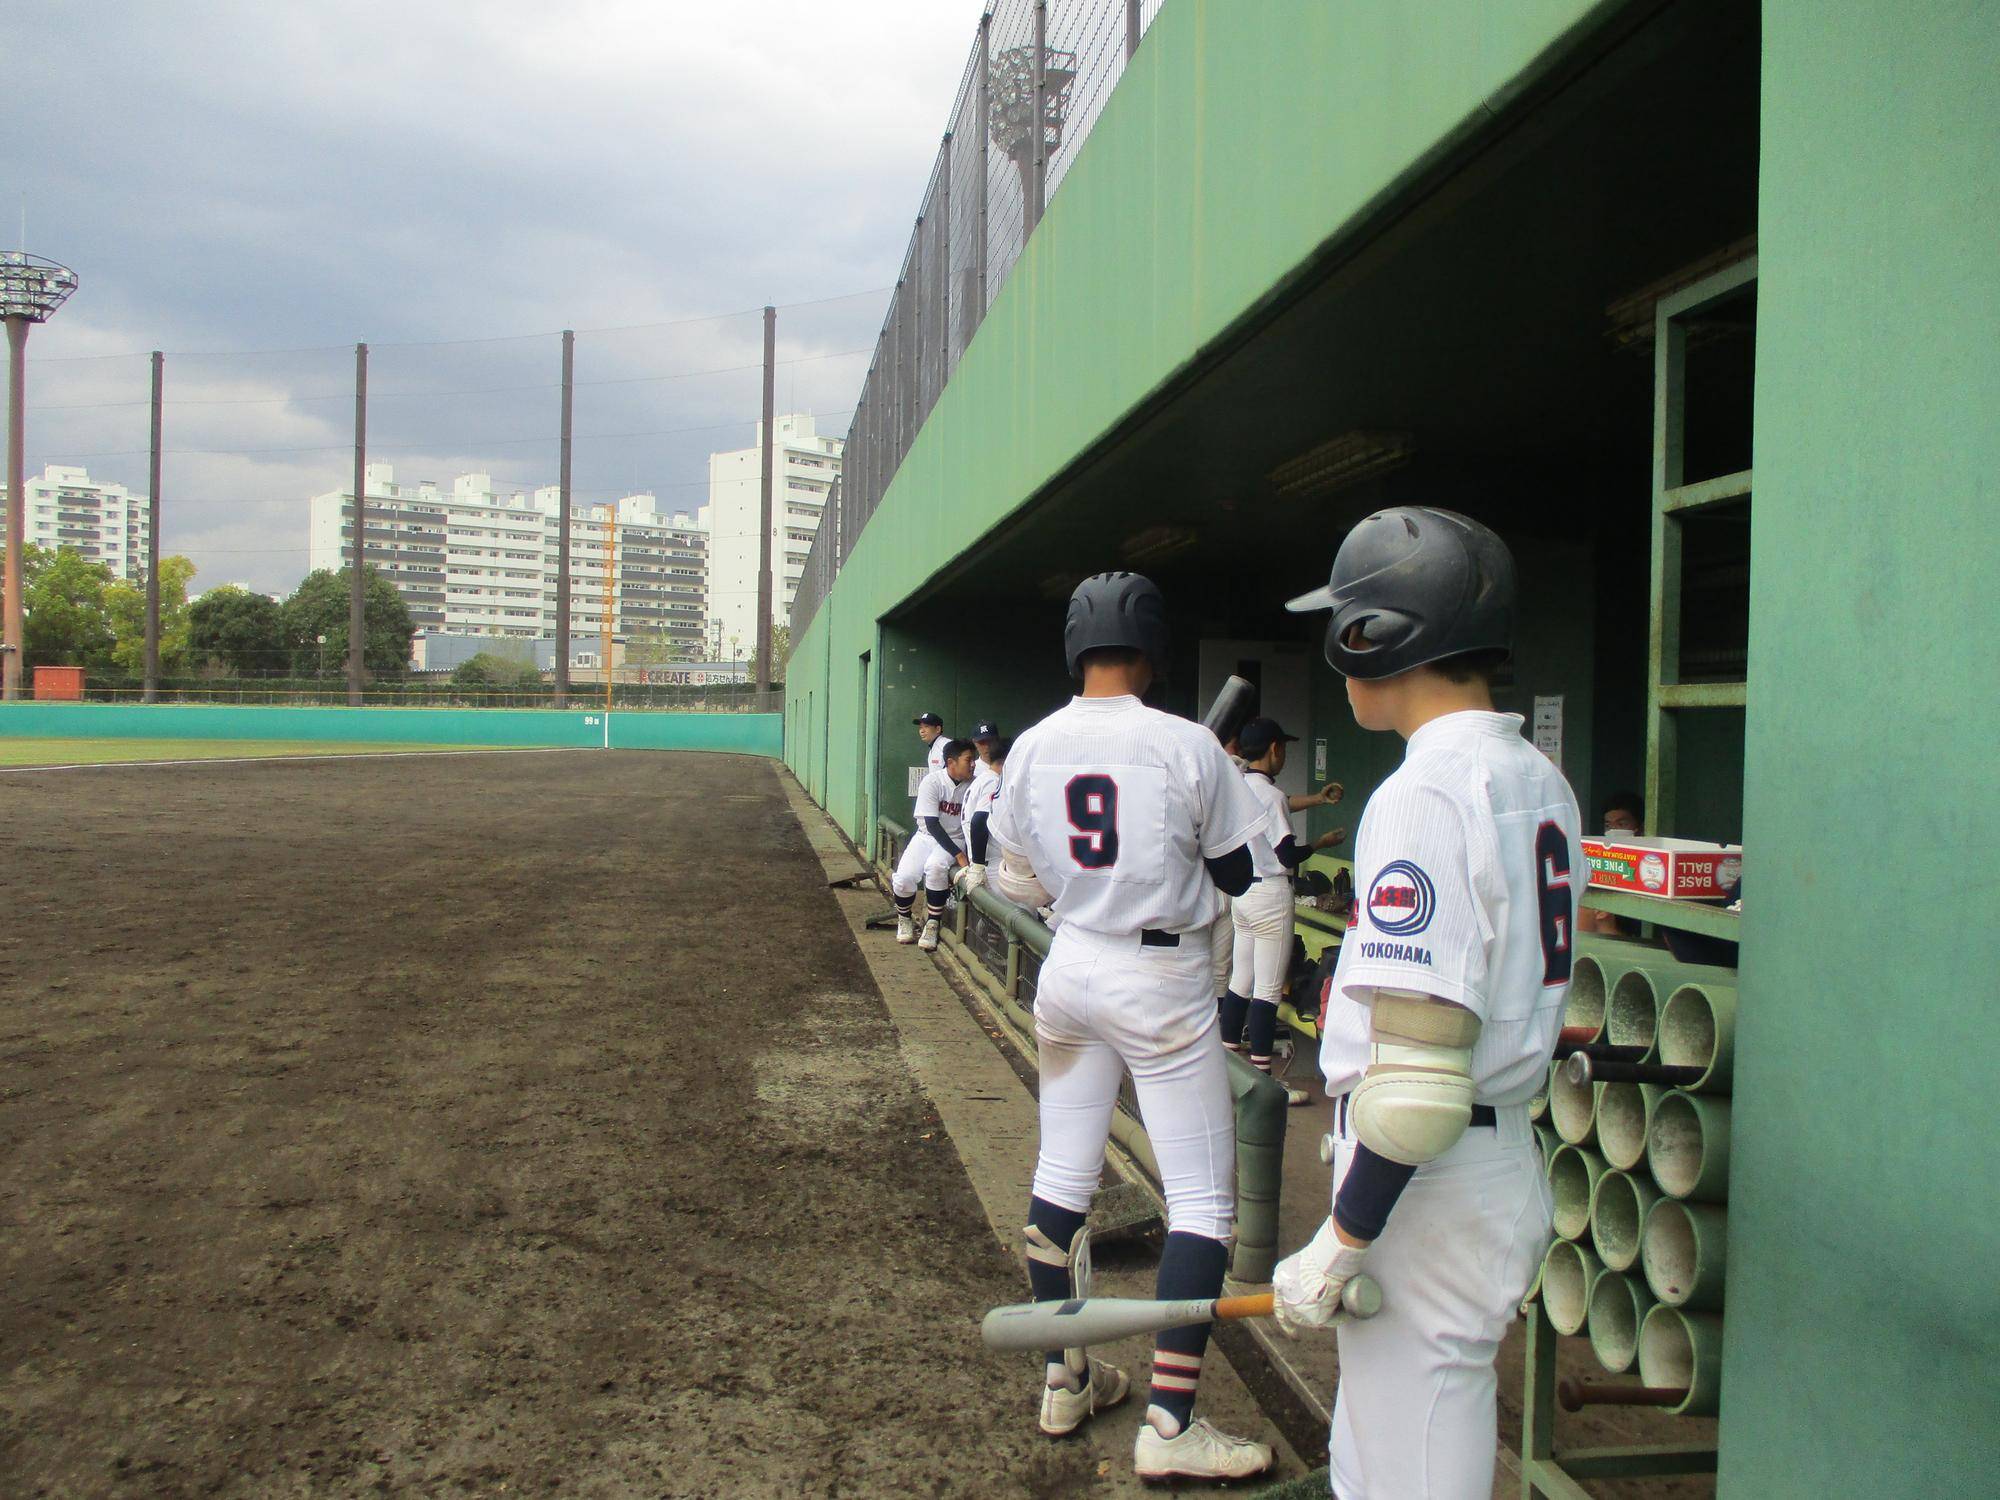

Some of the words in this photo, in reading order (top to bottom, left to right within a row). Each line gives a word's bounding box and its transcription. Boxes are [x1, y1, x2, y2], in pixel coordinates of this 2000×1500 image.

[772, 527, 778, 537] 8
[648, 671, 691, 684] CREATE
[1064, 773, 1120, 870] 9
[1602, 850, 1637, 861] MATSUKAN
[1604, 860, 1624, 872] PINE
[1678, 862, 1712, 873] BALL
[1678, 875, 1712, 888] BASE
[1535, 819, 1572, 987] 6
[1360, 942, 1432, 966] YOKOHAMA
